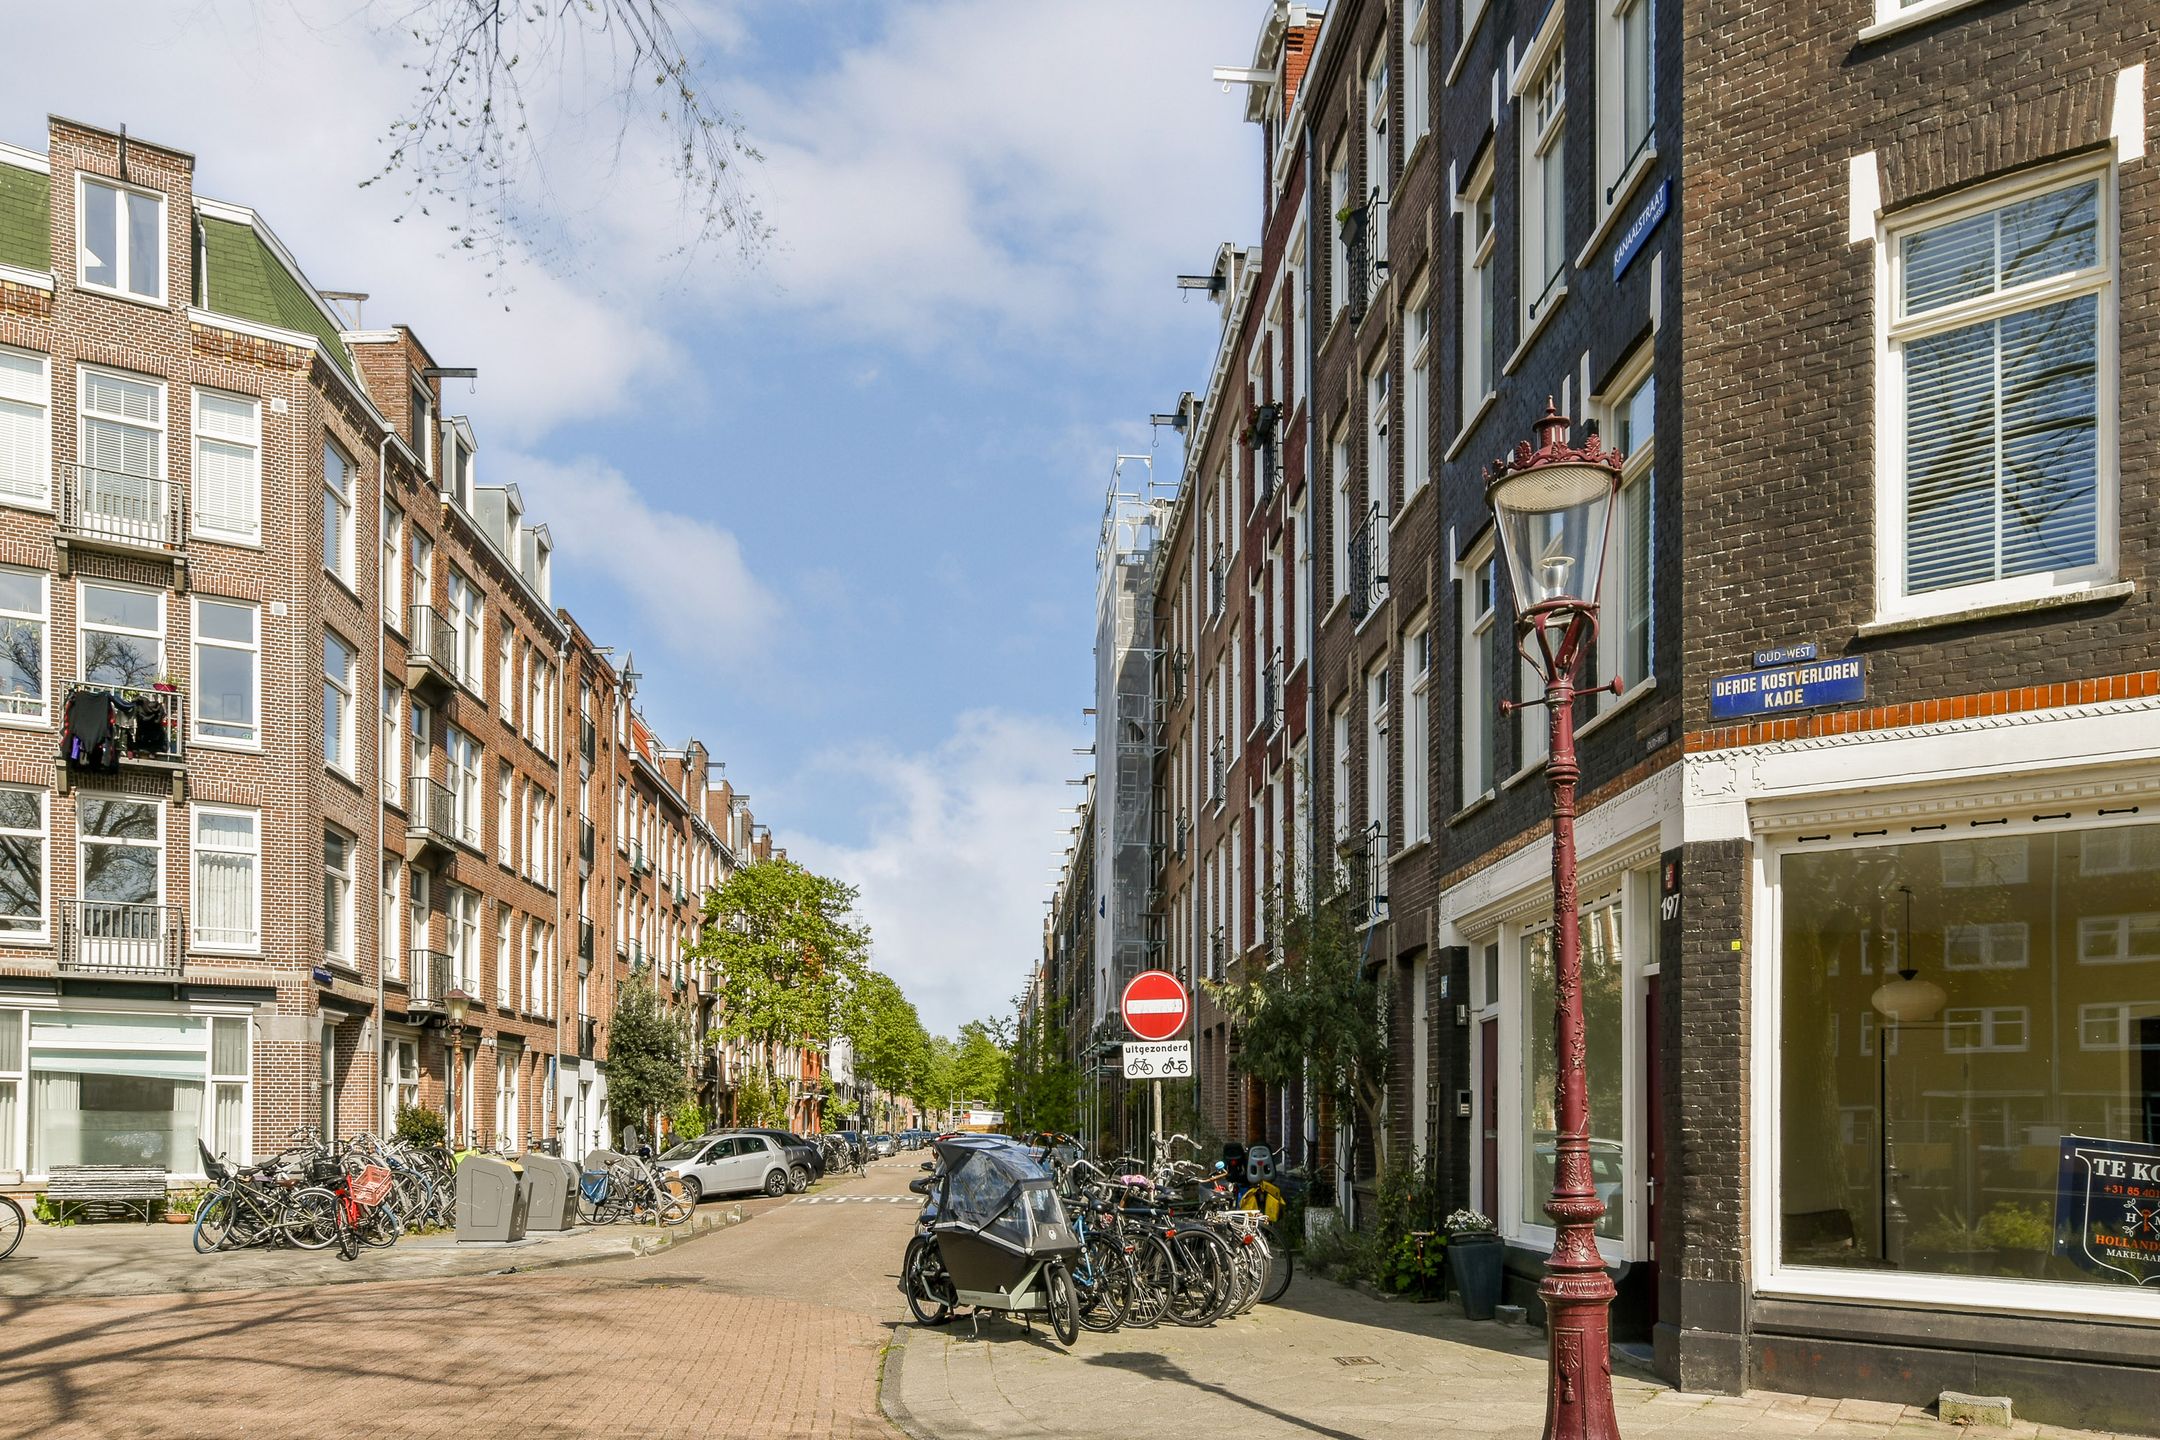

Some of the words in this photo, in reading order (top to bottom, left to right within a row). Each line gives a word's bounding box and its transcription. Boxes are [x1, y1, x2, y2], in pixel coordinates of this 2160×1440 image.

[1614, 184, 1664, 266] KANAALSTRAAT
[1758, 646, 1811, 663] OUD-WEST
[1716, 677, 1756, 697] DERDE
[1761, 661, 1859, 691] KOSTVERLOREN
[1764, 688, 1804, 708] KADE
[1661, 893, 1680, 920] 197
[1125, 1044, 1188, 1055] uitgezonderd
[2093, 1158, 2126, 1178] TE
[2103, 1185, 2124, 1195] +31
[2126, 1186, 2140, 1197] 85
[2126, 1212, 2137, 1223] H
[2096, 1234, 2160, 1251] HOLLAND
